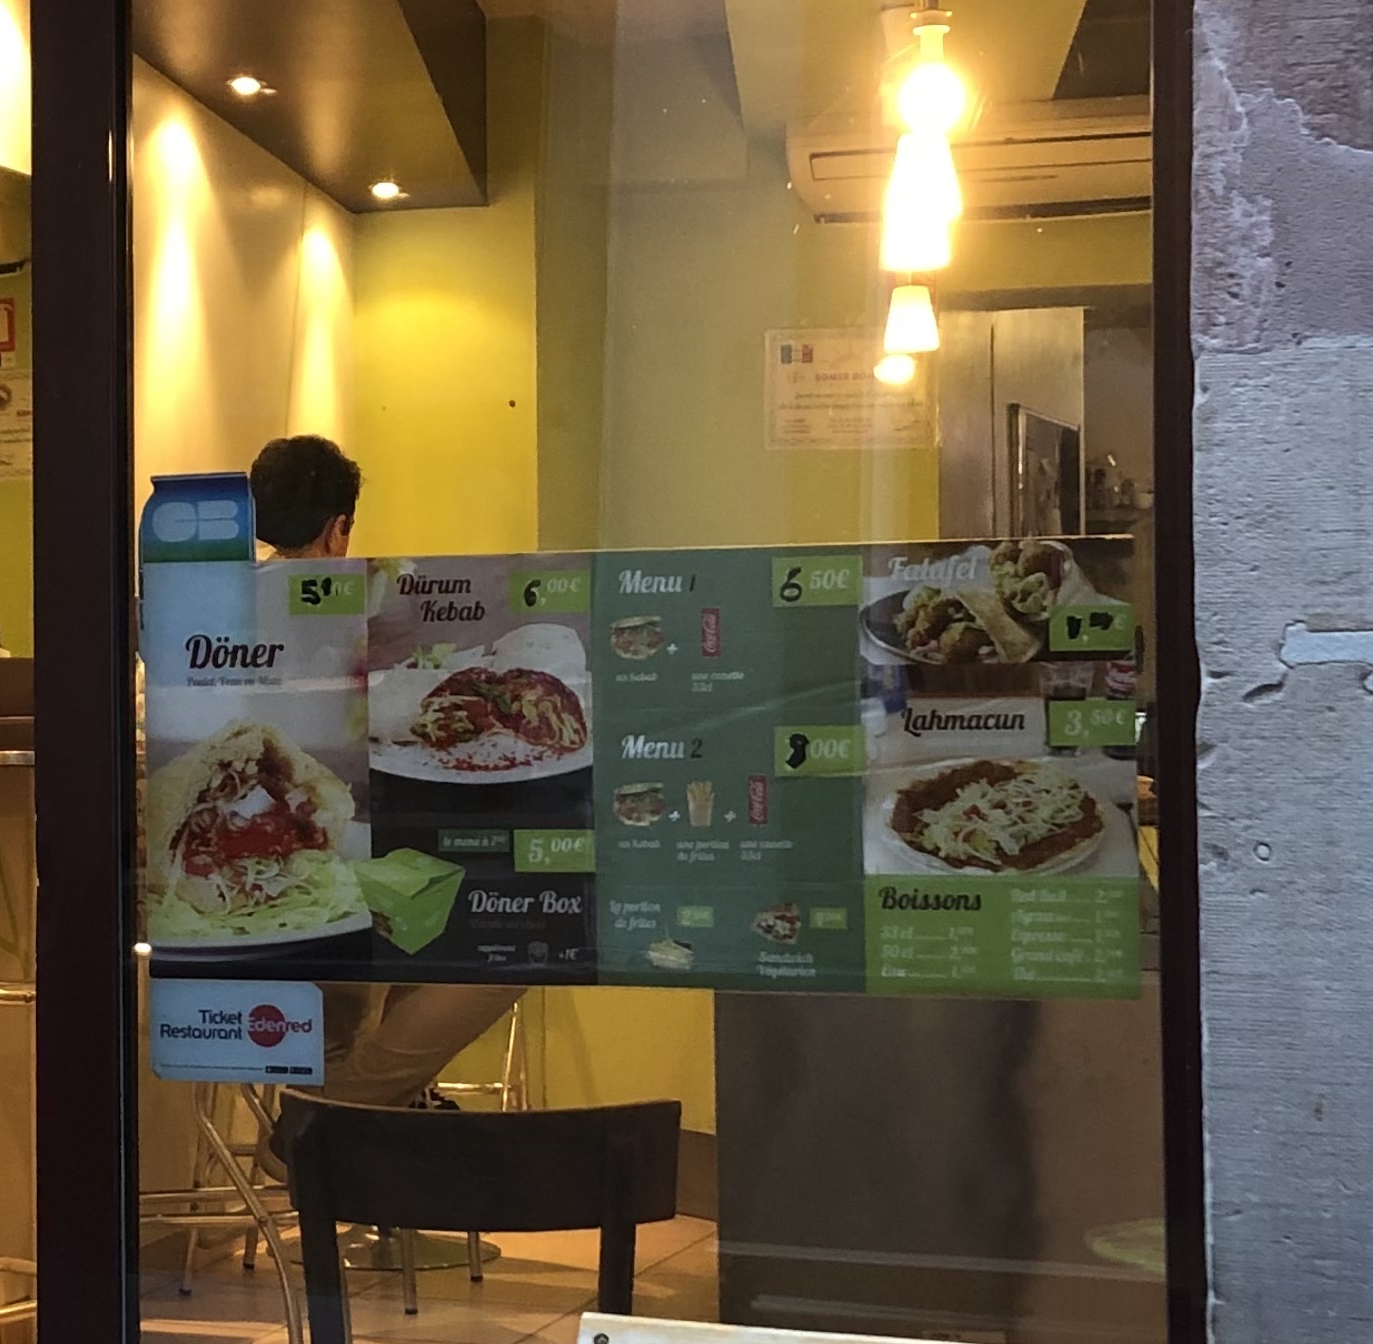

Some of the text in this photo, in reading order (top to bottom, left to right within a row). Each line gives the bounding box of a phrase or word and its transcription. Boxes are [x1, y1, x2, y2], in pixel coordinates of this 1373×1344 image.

[618, 570, 682, 594] Menu
[888, 556, 977, 587] Falafel
[396, 574, 471, 596] Dürum
[420, 599, 486, 623] Kebab
[185, 634, 285, 669] Döner
[901, 708, 1025, 737] Lahmacun
[621, 735, 704, 759] Menu 2
[468, 890, 583, 914] Döner Box
[878, 885, 982, 911] Boissons
[199, 1010, 242, 1024] Ticket
[248, 1017, 313, 1033] Edenred
[160, 1024, 242, 1040] Restaurant
